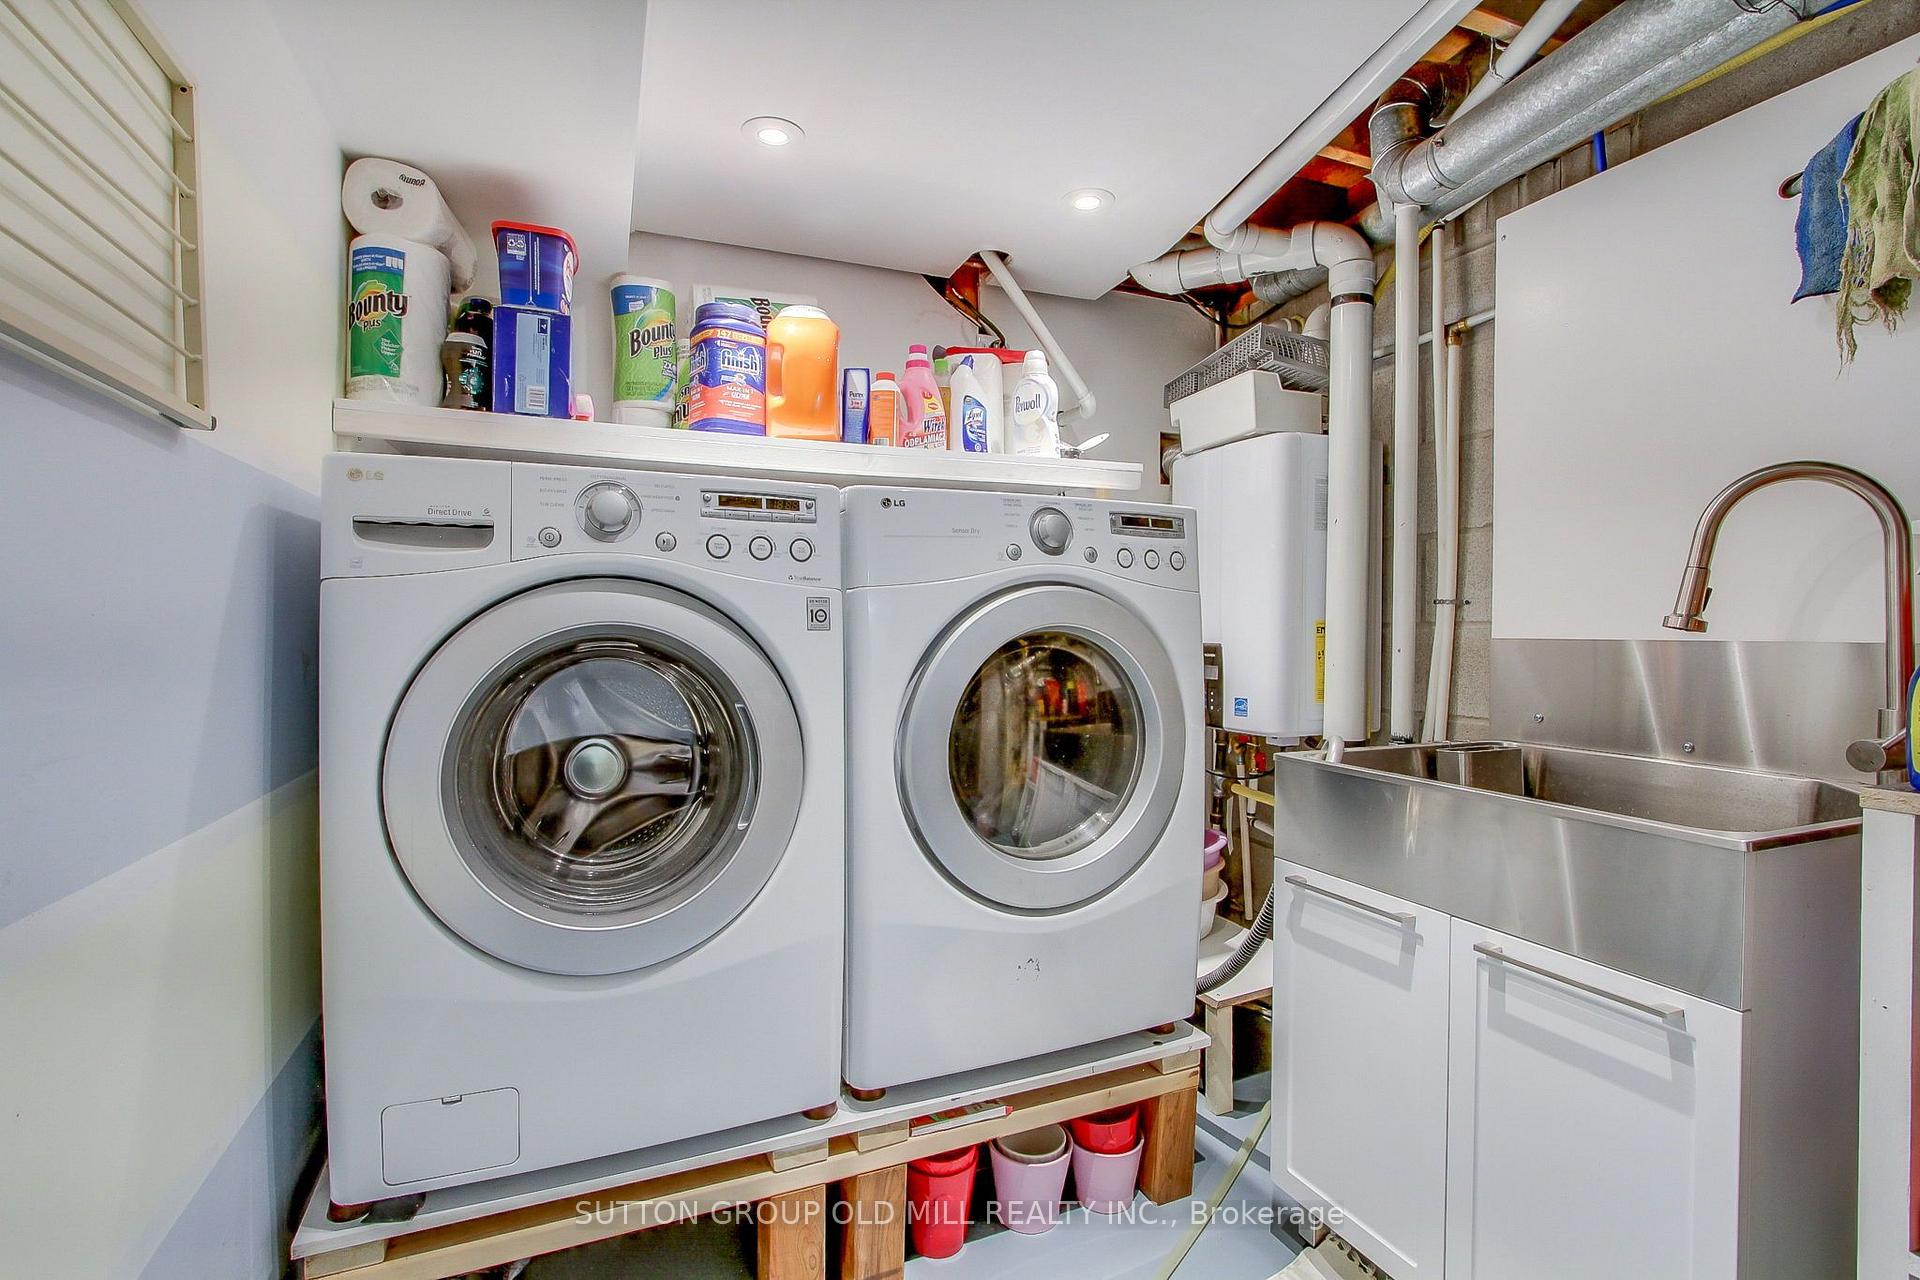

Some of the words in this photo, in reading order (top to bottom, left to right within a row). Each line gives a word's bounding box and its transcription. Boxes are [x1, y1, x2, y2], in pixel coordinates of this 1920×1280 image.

[348, 291, 409, 331] Bounty
[721, 348, 759, 373] finish
[1015, 393, 1042, 414] Perwoll
[427, 507, 451, 516] Direct
[452, 508, 472, 517] Drive
